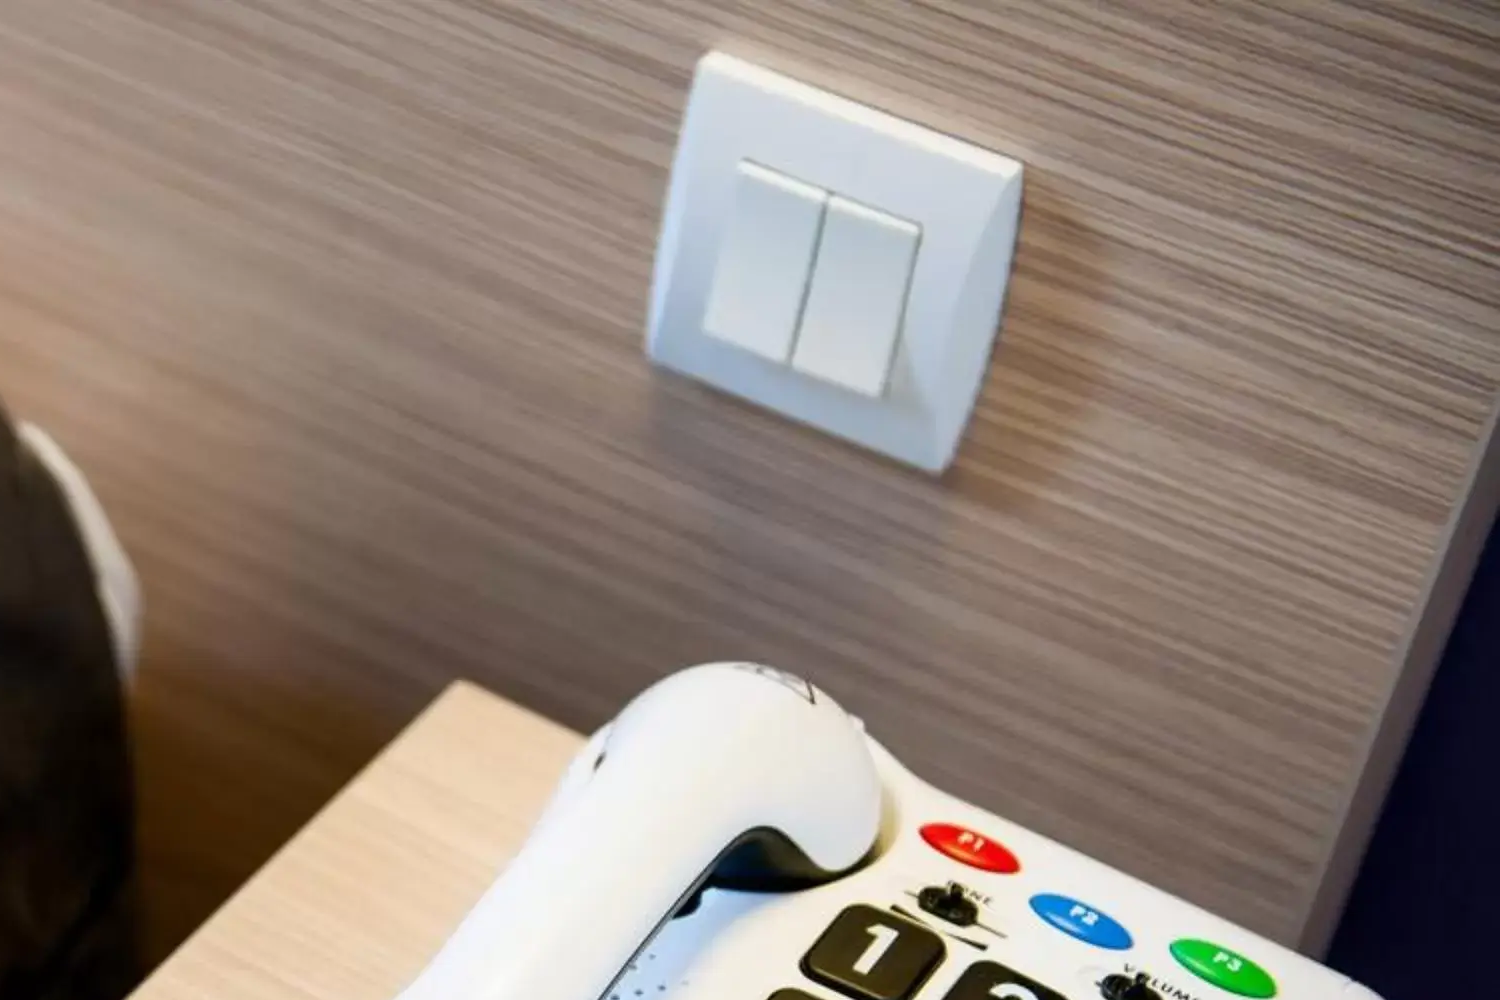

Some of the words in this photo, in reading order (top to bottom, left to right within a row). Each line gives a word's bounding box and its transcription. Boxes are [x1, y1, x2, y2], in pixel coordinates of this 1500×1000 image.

[958, 832, 984, 851] P1
[1070, 906, 1099, 925] P2
[852, 923, 899, 975] 1
[1213, 951, 1241, 972] P3
